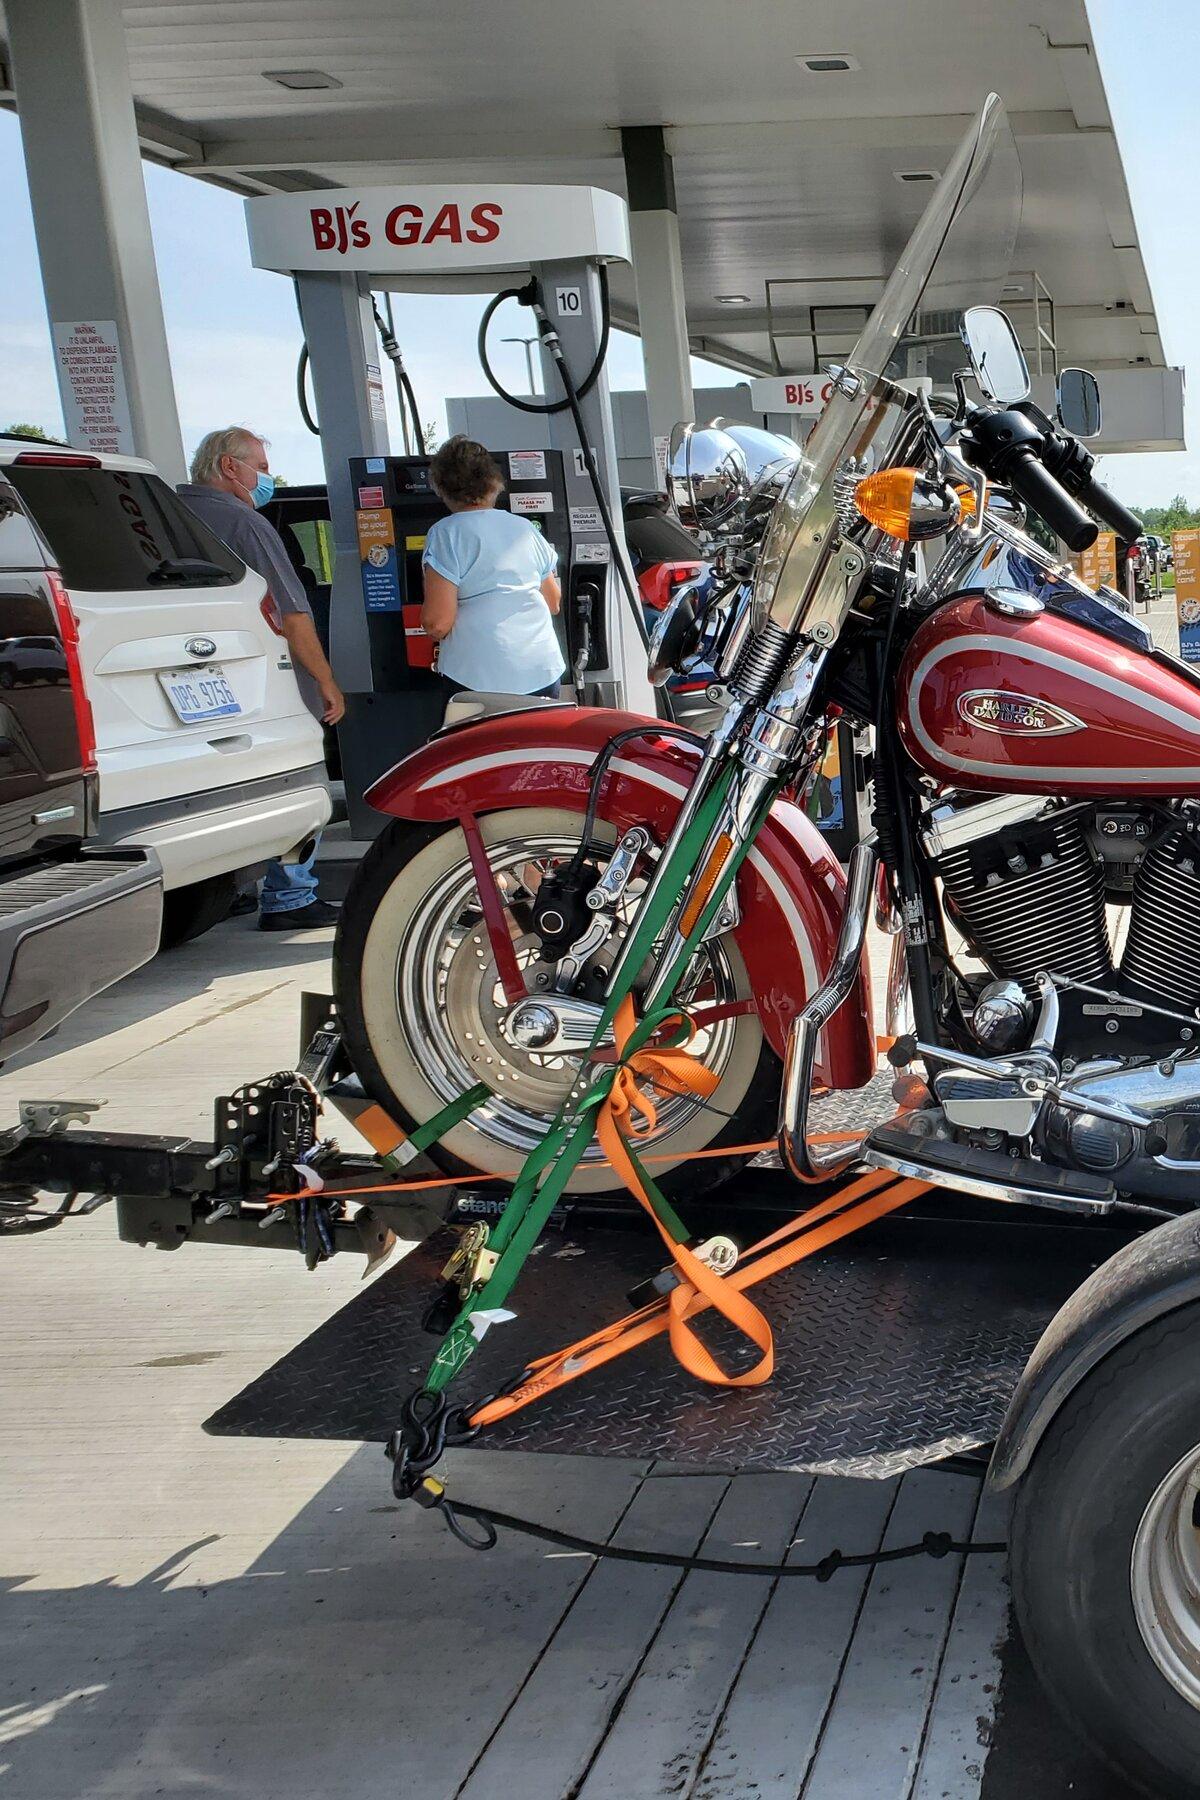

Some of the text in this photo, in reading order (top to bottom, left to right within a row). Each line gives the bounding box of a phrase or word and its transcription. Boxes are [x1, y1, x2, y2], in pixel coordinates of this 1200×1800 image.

[310, 201, 503, 254] BJ's GAS
[558, 292, 579, 311] 10
[785, 381, 814, 405] BJ's
[199, 680, 235, 707] 9756
